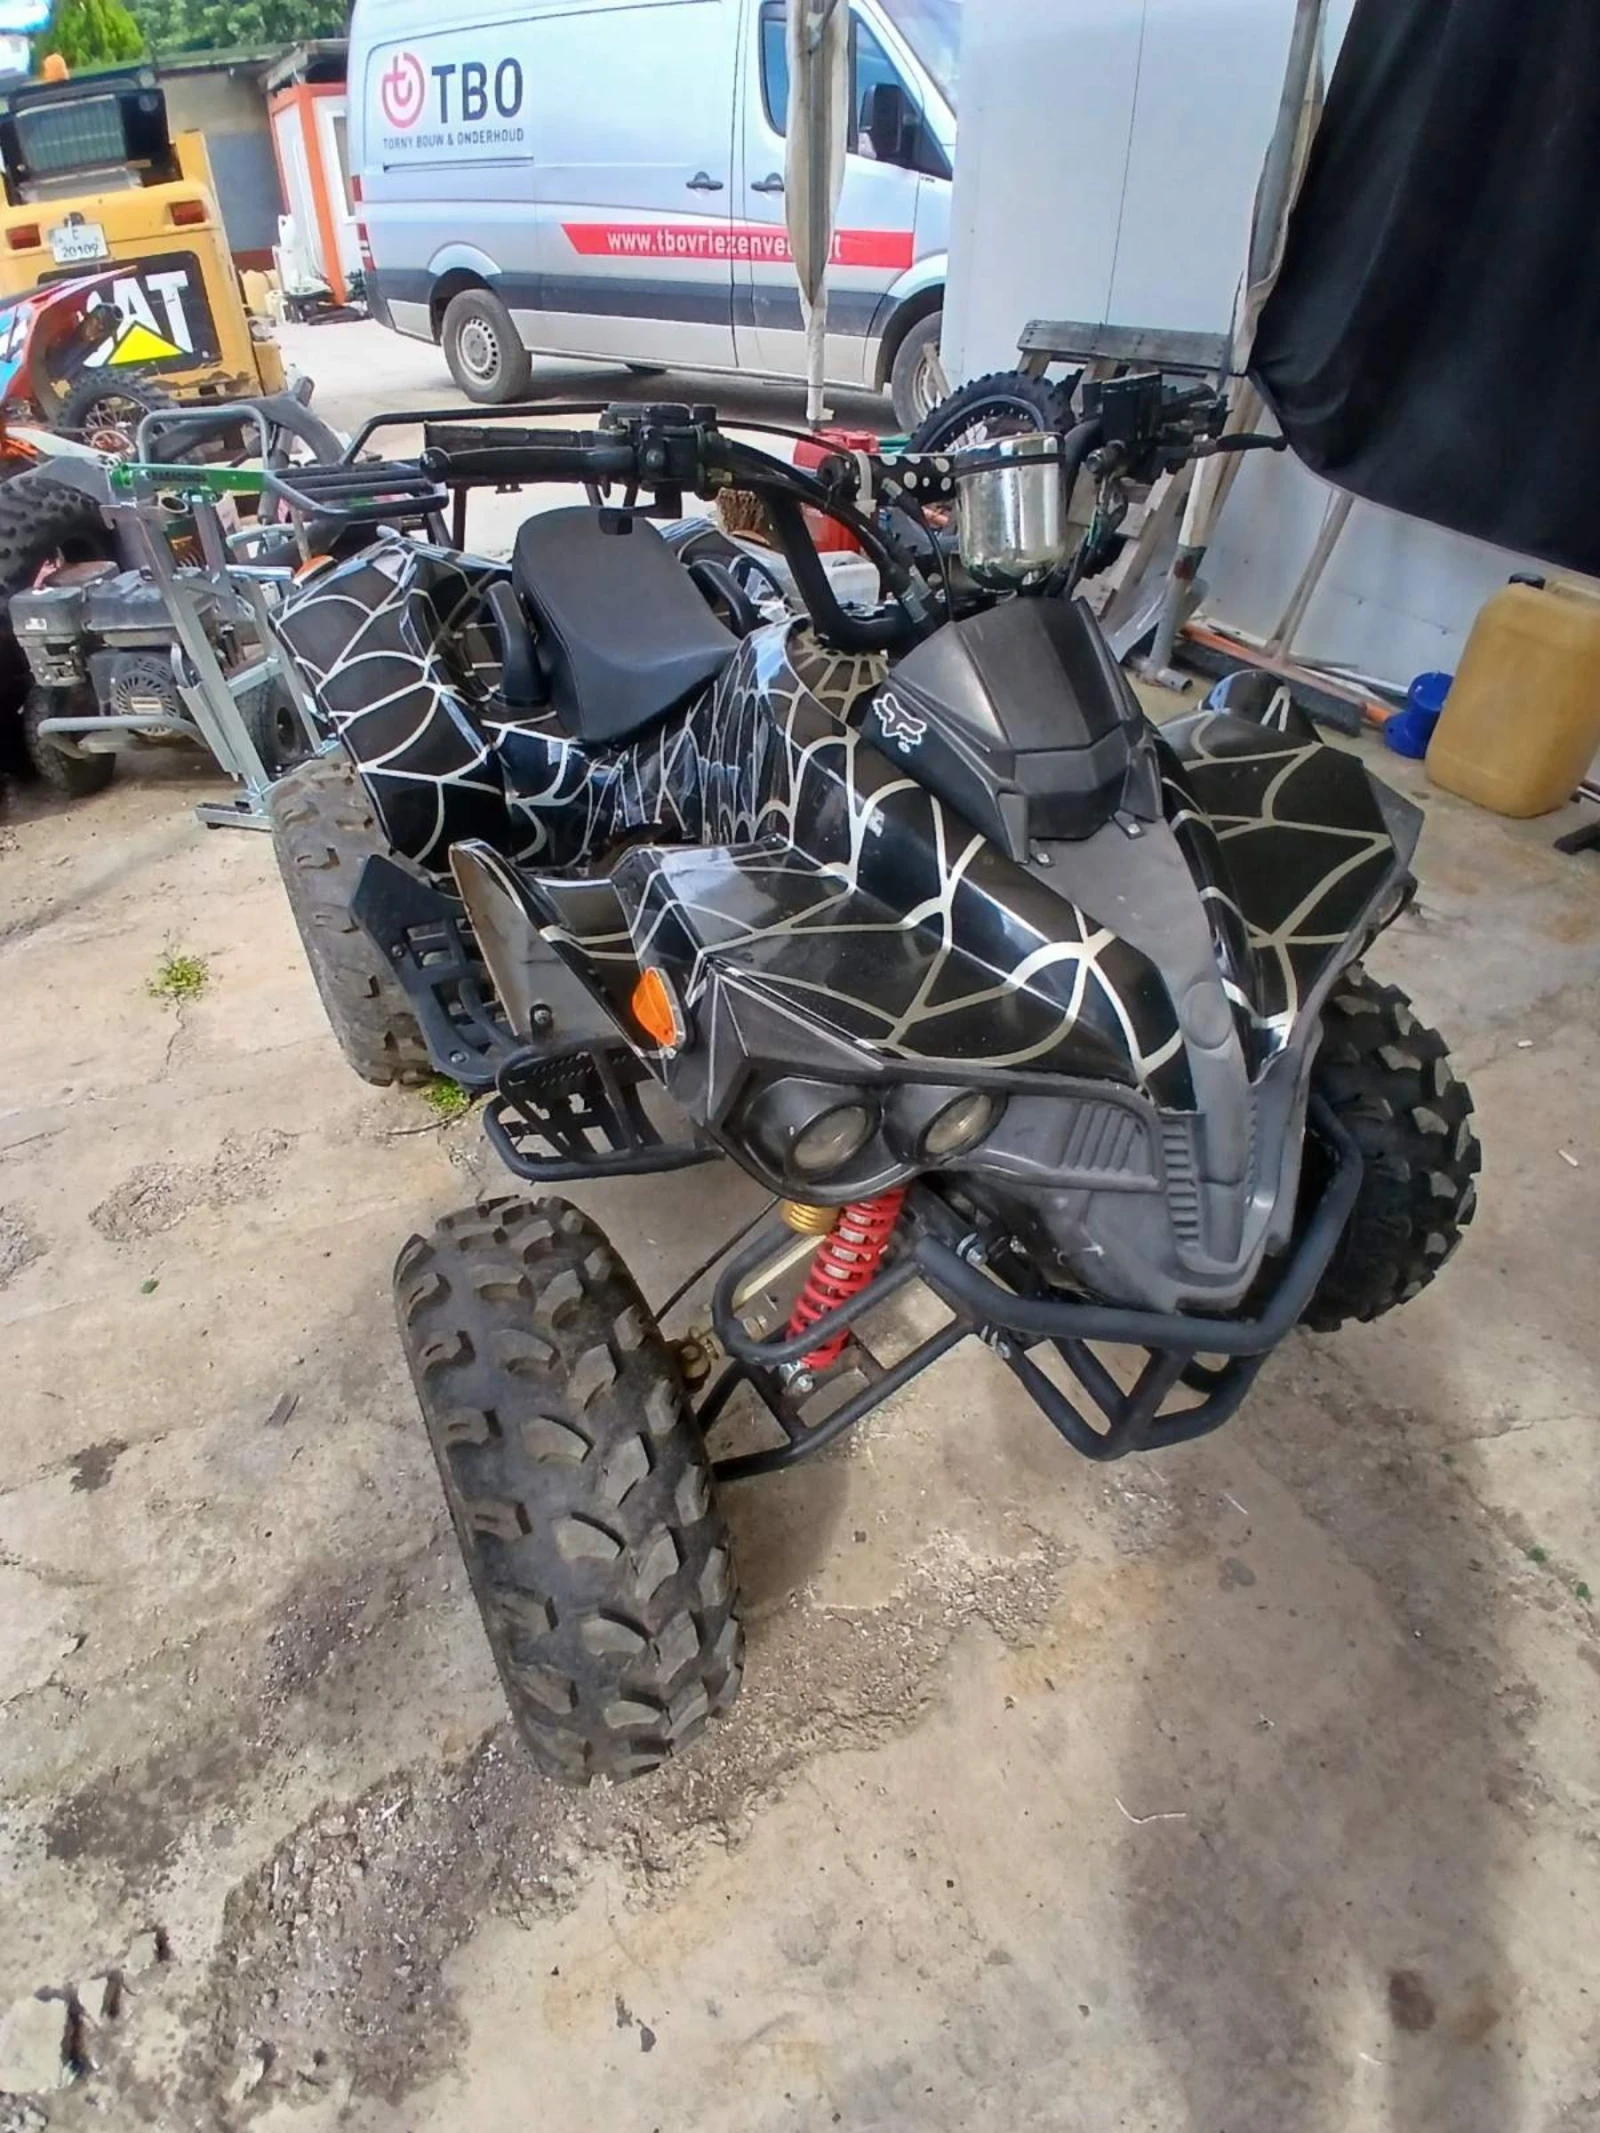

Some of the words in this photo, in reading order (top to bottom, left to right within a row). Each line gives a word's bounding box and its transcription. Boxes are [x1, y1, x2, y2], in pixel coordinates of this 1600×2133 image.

[431, 57, 523, 124] TBO
[383, 137, 413, 150] TORNY
[416, 132, 444, 149] BOUW
[447, 133, 454, 146] &
[457, 127, 525, 145] ONDERHOUD
